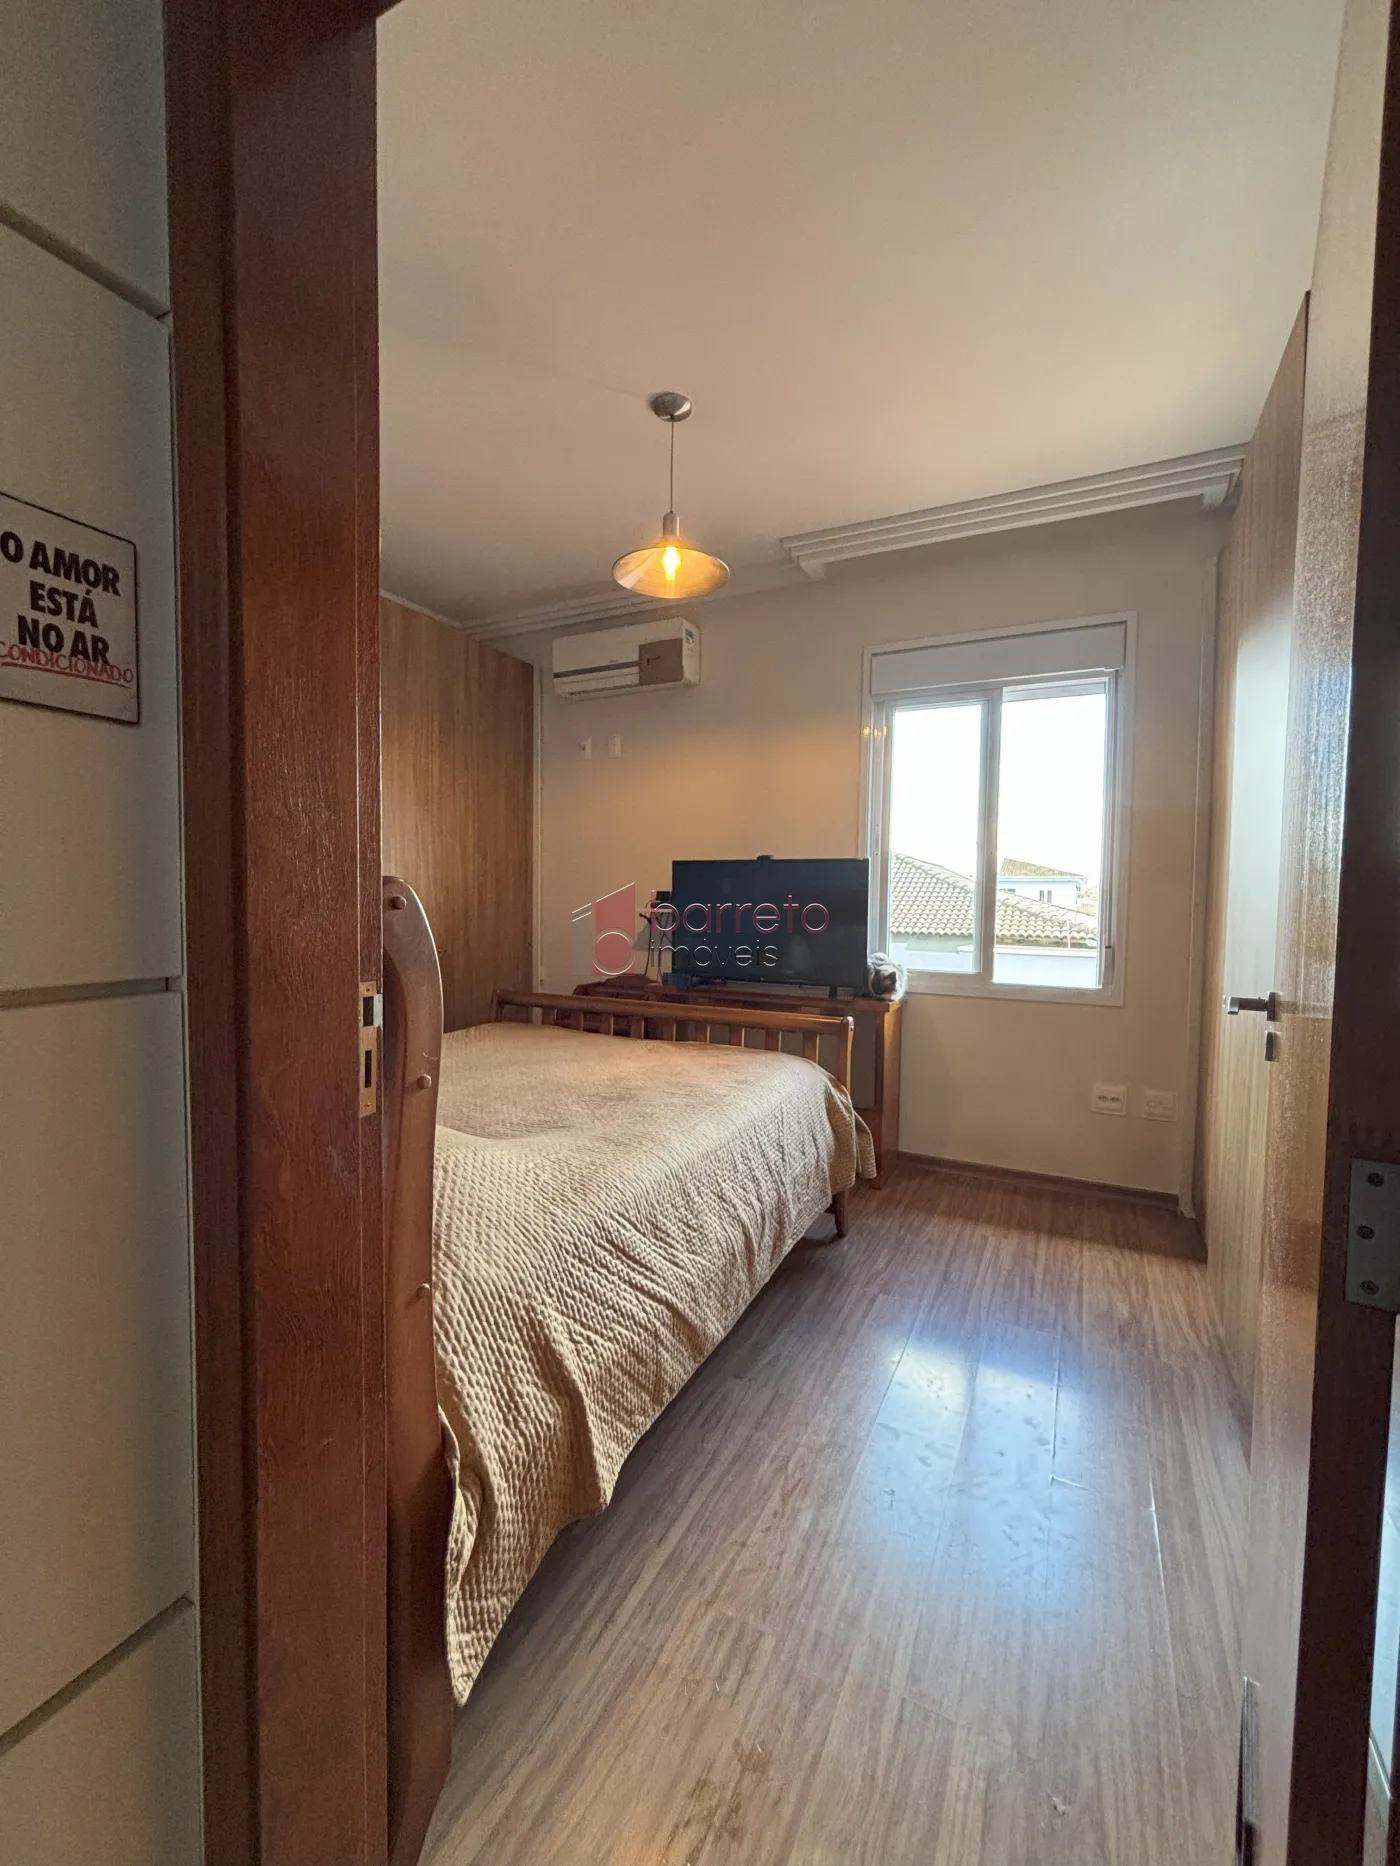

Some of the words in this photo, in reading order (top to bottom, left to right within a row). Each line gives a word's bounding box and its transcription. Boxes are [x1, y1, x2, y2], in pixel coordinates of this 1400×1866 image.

[0, 531, 24, 563] O
[29, 540, 121, 596] AMOR
[29, 580, 99, 628] ESTÁ
[17, 614, 65, 653] NO
[71, 630, 111, 665] AR
